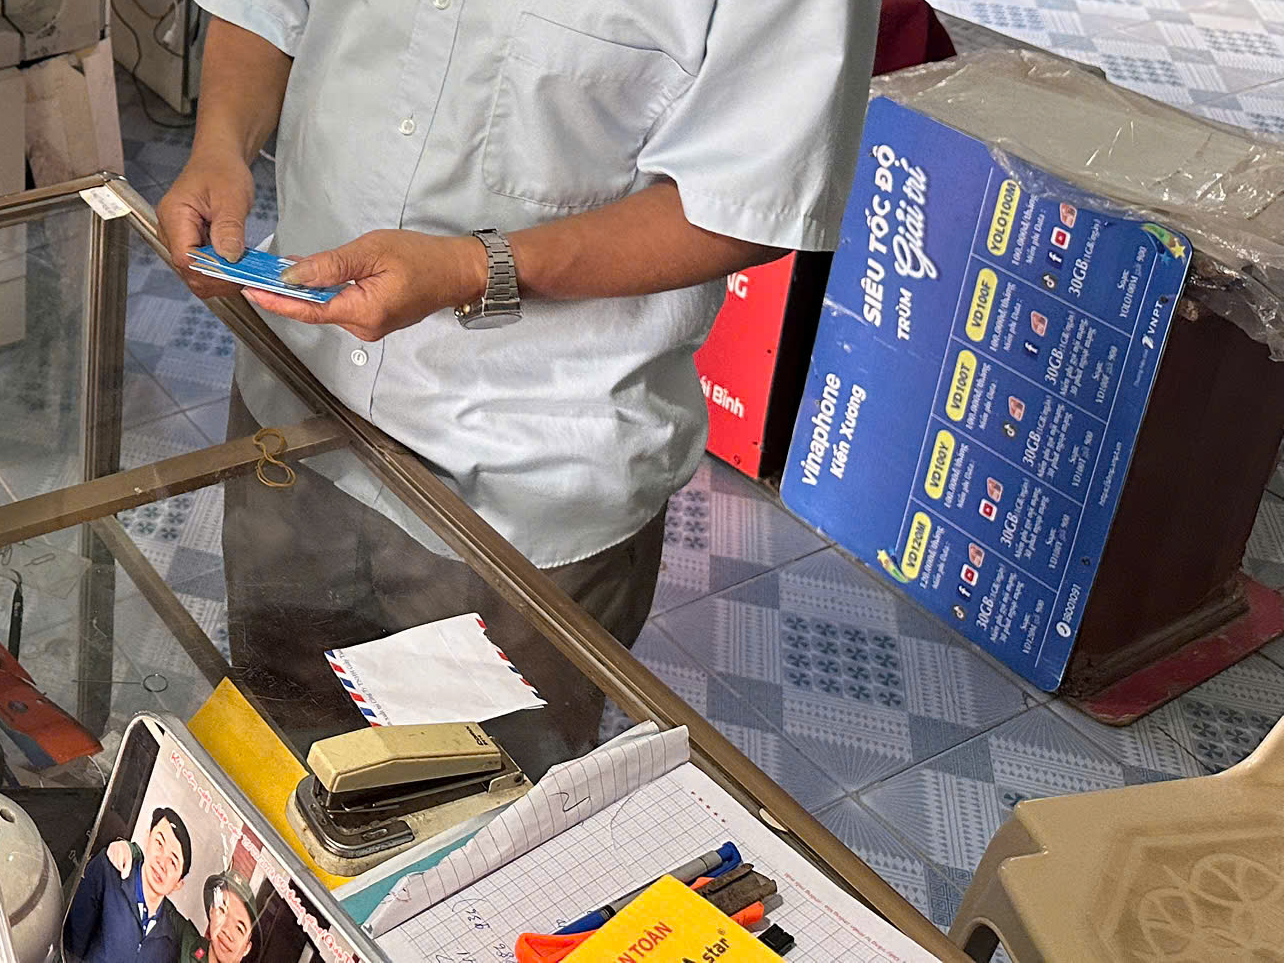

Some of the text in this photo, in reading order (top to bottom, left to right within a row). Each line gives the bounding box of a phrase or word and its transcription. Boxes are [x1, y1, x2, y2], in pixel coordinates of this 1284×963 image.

[860, 144, 900, 328] SIÊU TỐC ĐỘ
[894, 197, 938, 278] Giải
[990, 182, 1015, 250] YOLO100M
[894, 286, 912, 340] TRÙM
[971, 280, 990, 327] VD100F
[1147, 300, 1162, 333] VNPT
[712, 383, 745, 418] Bình
[950, 362, 969, 409] VD100T
[801, 374, 839, 484] vinaphone
[829, 384, 866, 478] Kiến Xương
[929, 441, 948, 487] VD100Y
[906, 521, 925, 567] VD120M
